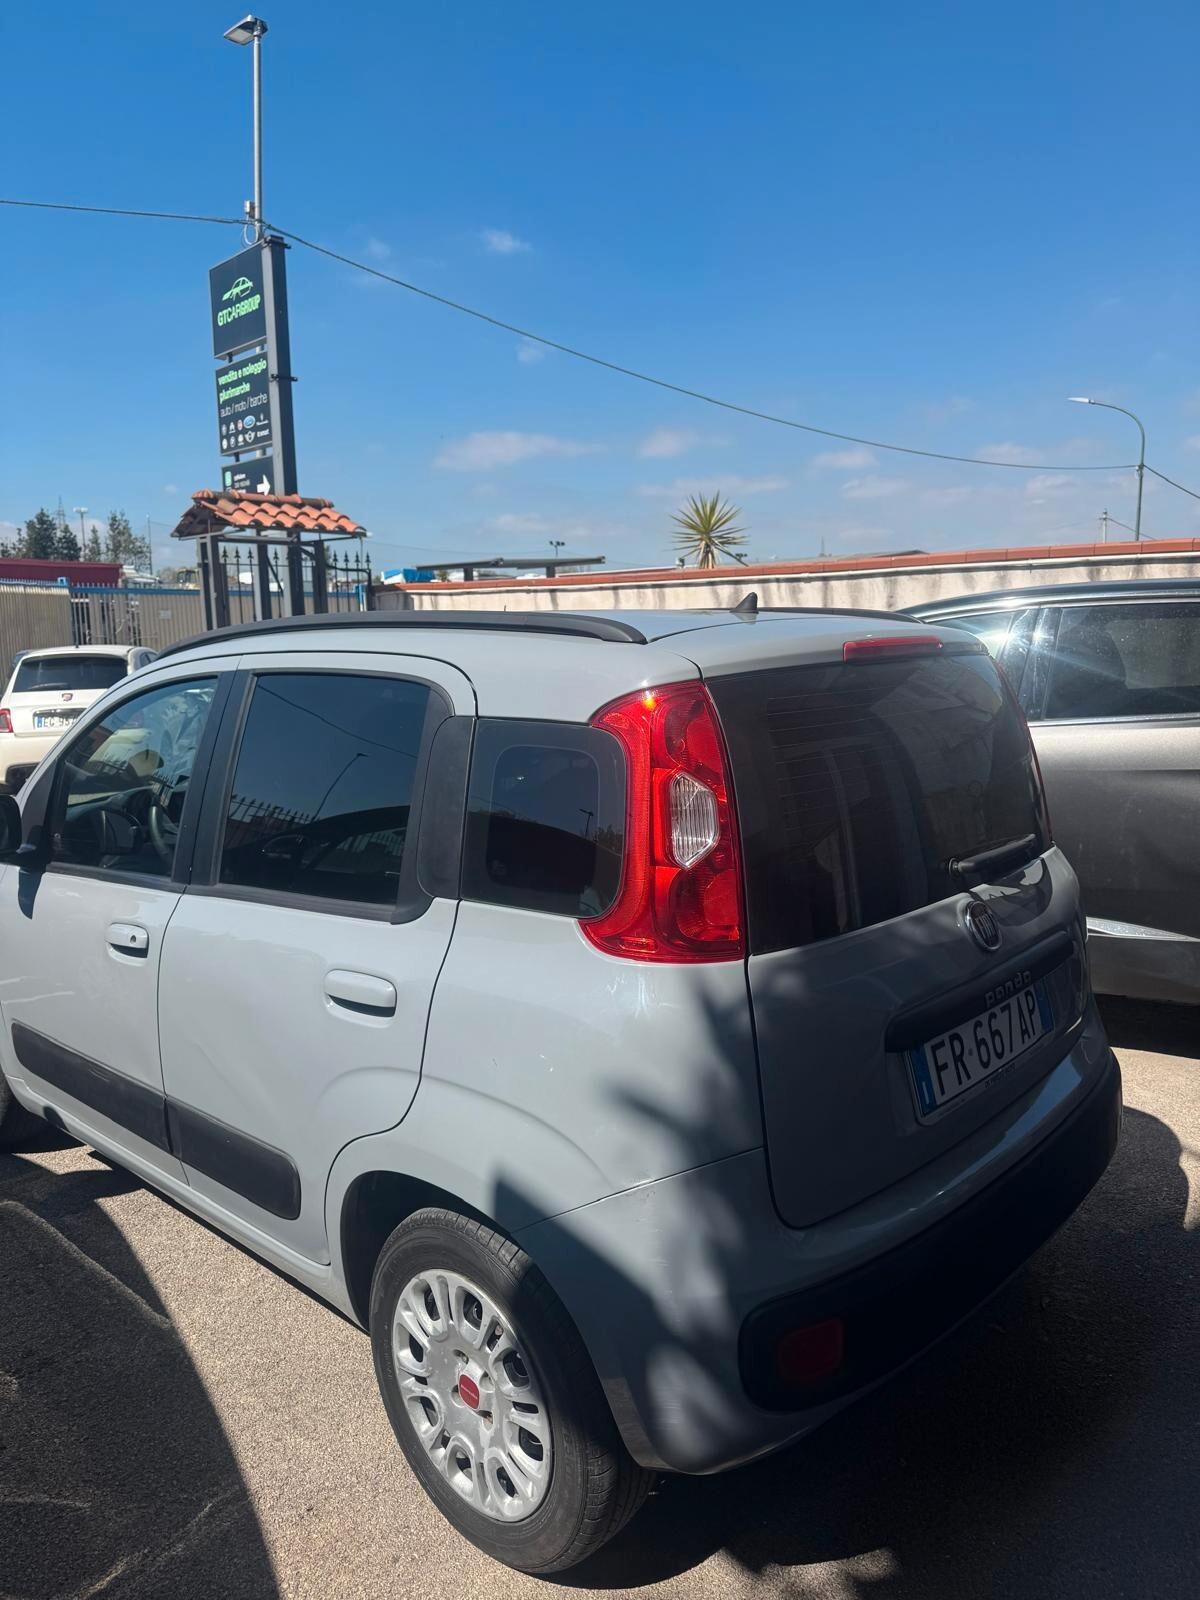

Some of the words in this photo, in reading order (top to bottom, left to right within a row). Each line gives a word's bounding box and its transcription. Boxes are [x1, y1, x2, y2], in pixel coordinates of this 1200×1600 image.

[242, 358, 267, 377] noleggio
[219, 381, 251, 404] plurimarche
[220, 405, 231, 417] auto
[234, 400, 246, 413] moto
[250, 392, 267, 407] barche
[930, 1033, 971, 1096] FR
[973, 989, 1036, 1069] 667AP
